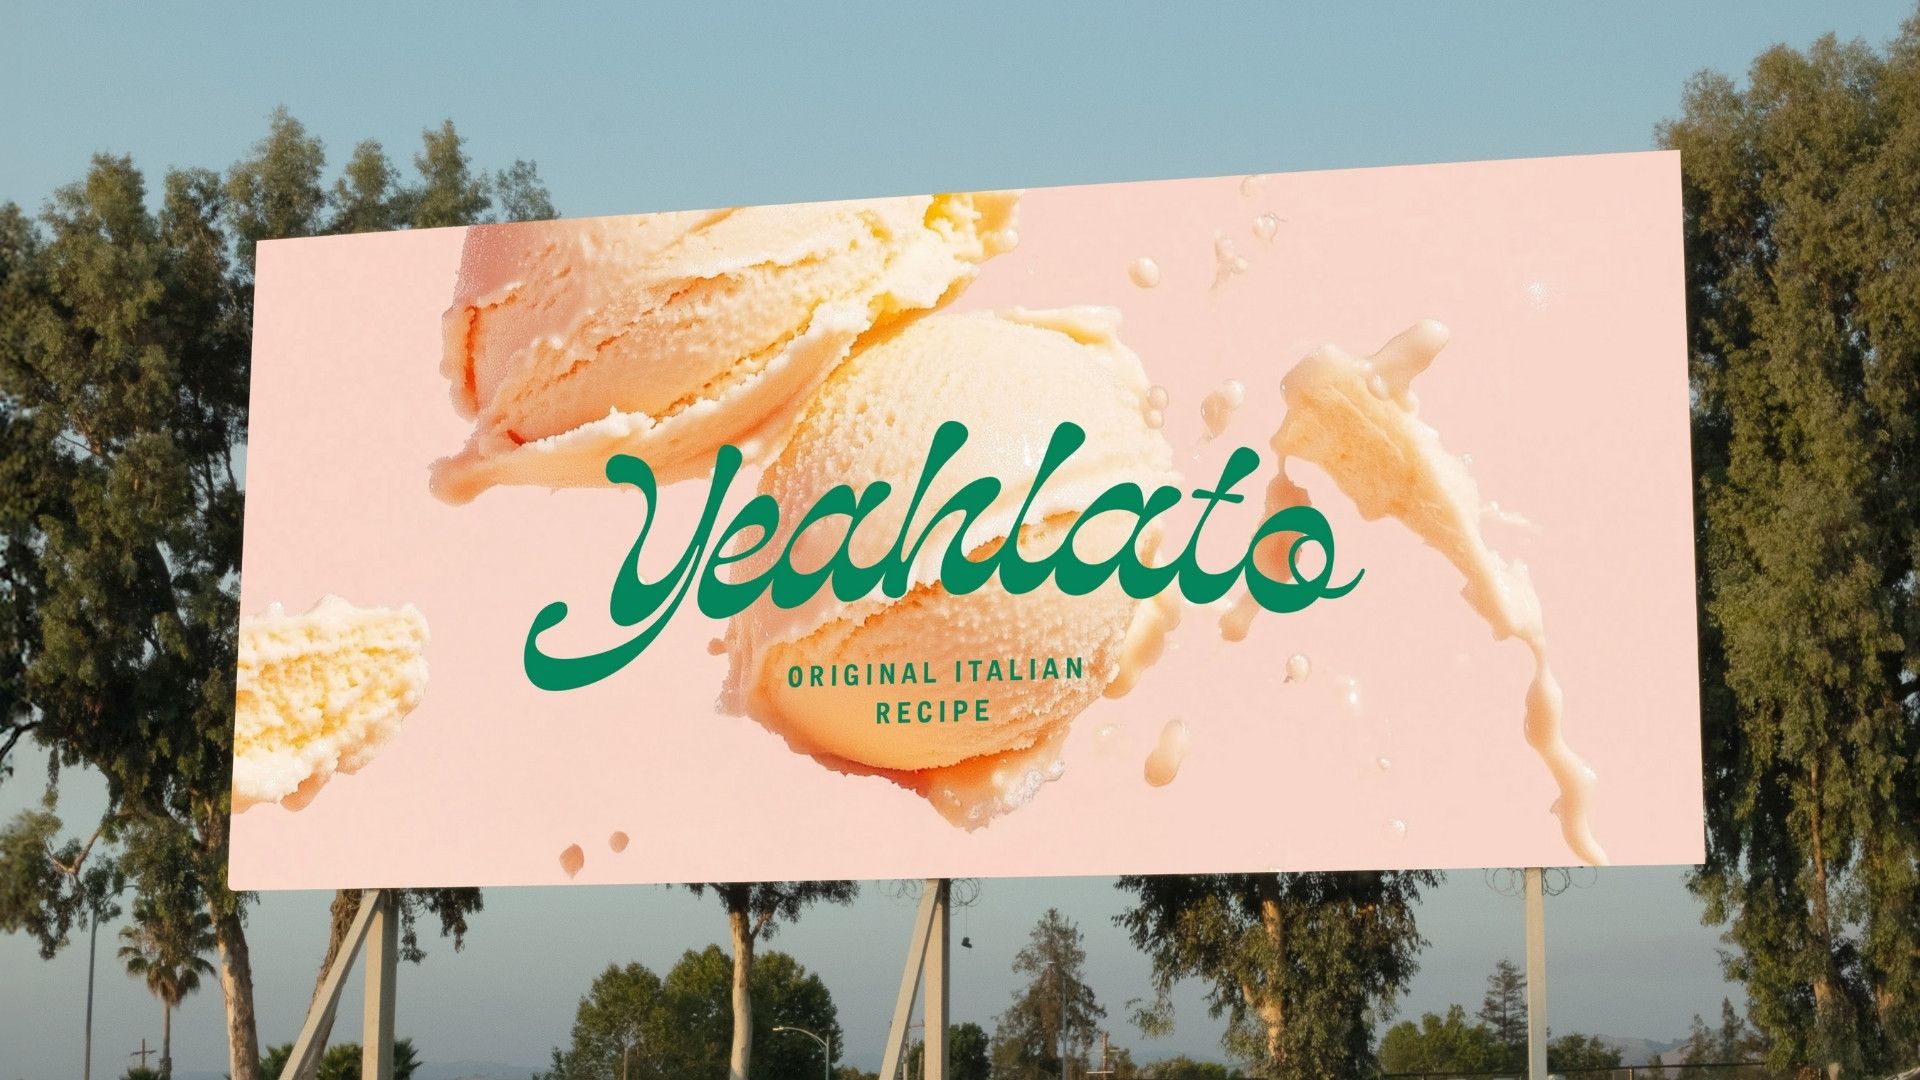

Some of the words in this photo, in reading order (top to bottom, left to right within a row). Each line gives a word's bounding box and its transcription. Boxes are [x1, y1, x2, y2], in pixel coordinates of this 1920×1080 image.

[523, 420, 1365, 691] Yeahlato
[788, 662, 937, 688] ORIGINAL
[955, 657, 1084, 683] ITALIAN
[876, 700, 989, 724] RECIPE
